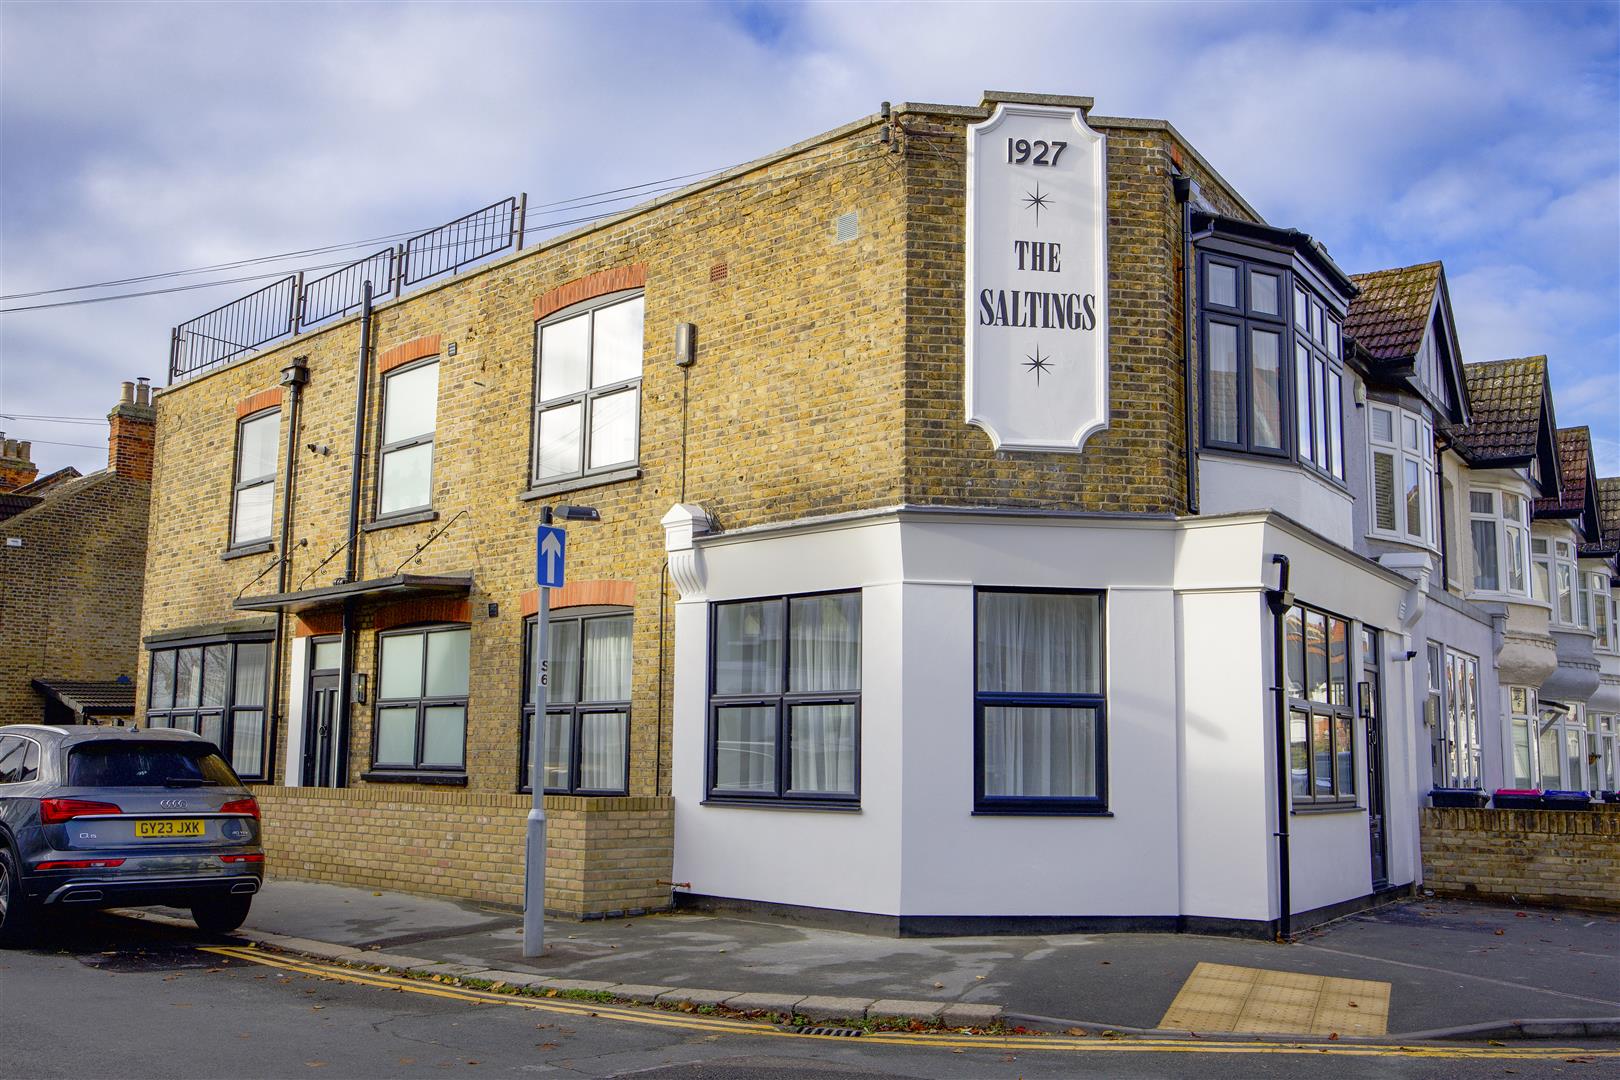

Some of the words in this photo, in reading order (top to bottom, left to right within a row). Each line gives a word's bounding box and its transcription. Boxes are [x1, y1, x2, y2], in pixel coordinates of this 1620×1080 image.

[1007, 138, 1068, 167] 1927
[1014, 240, 1061, 273] THE
[980, 288, 1096, 332] SALTINGS
[140, 822, 173, 834] GY23
[177, 822, 200, 833] JXK
